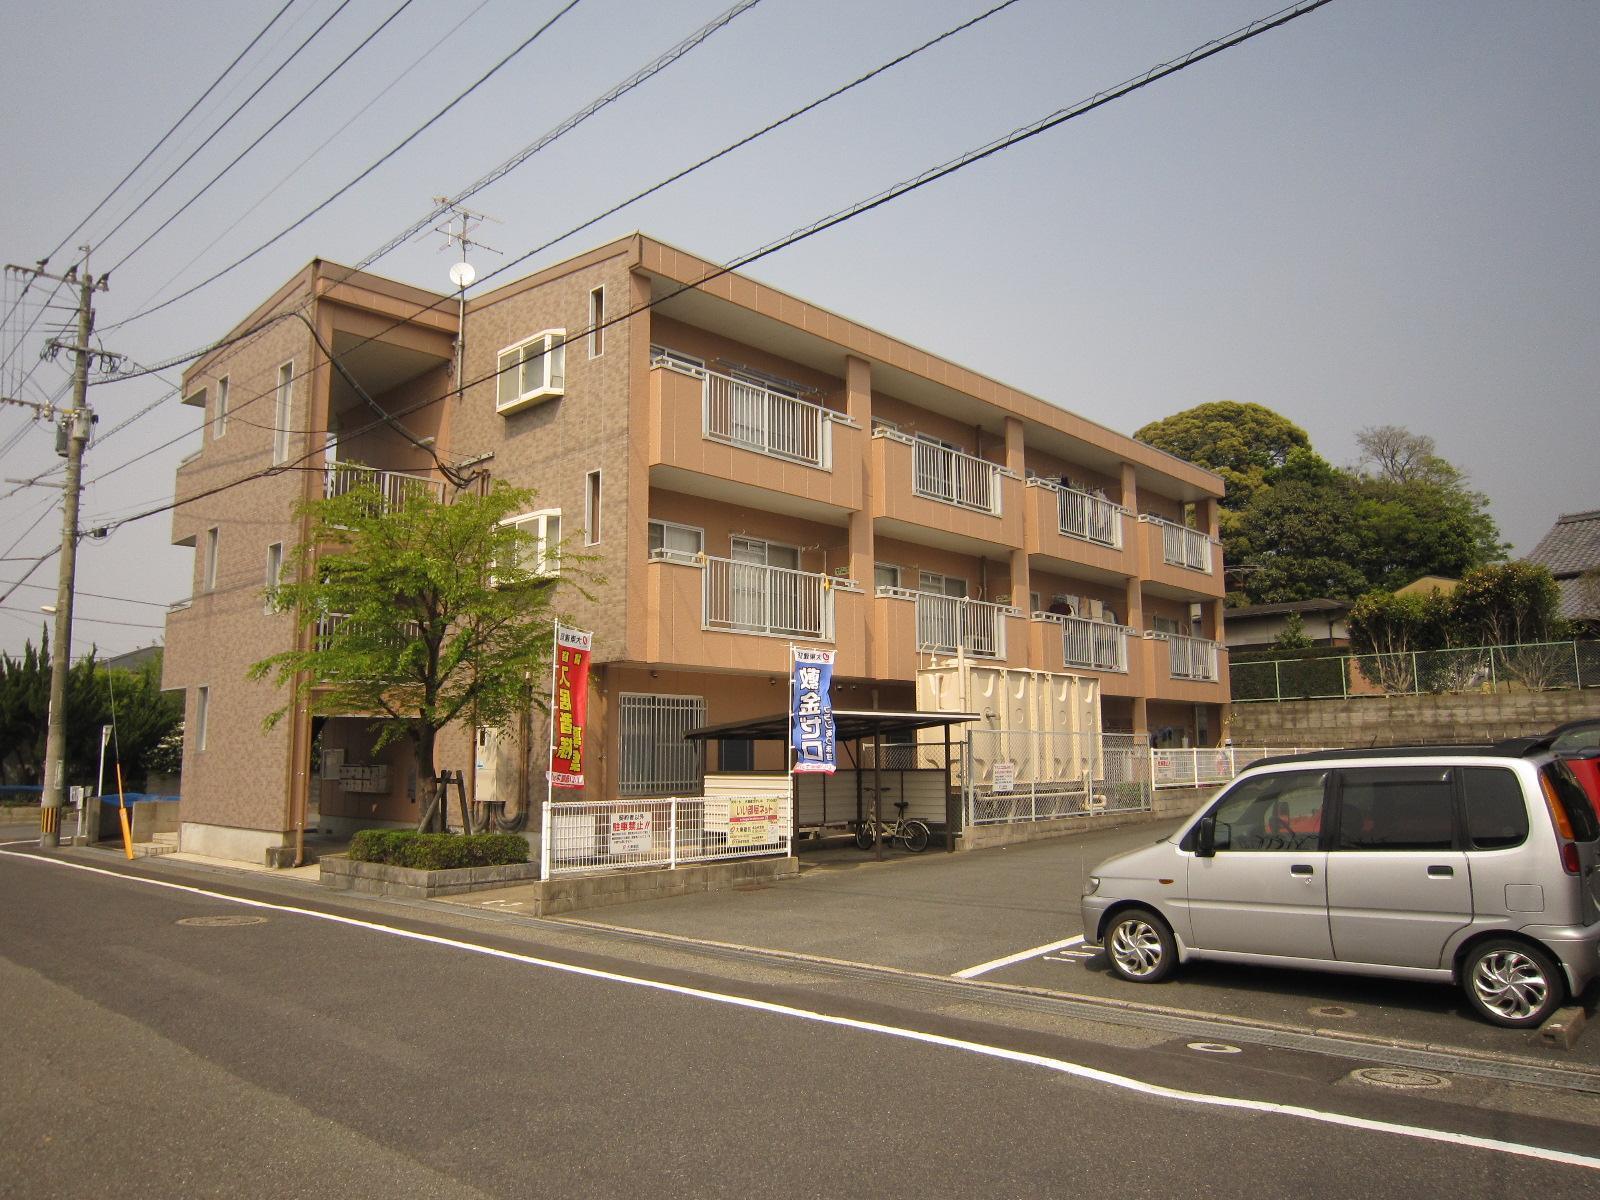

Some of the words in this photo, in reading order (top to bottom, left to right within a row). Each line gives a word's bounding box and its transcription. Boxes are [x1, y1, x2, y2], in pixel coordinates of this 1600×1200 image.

[736, 804, 773, 816] いい部屋ネット
